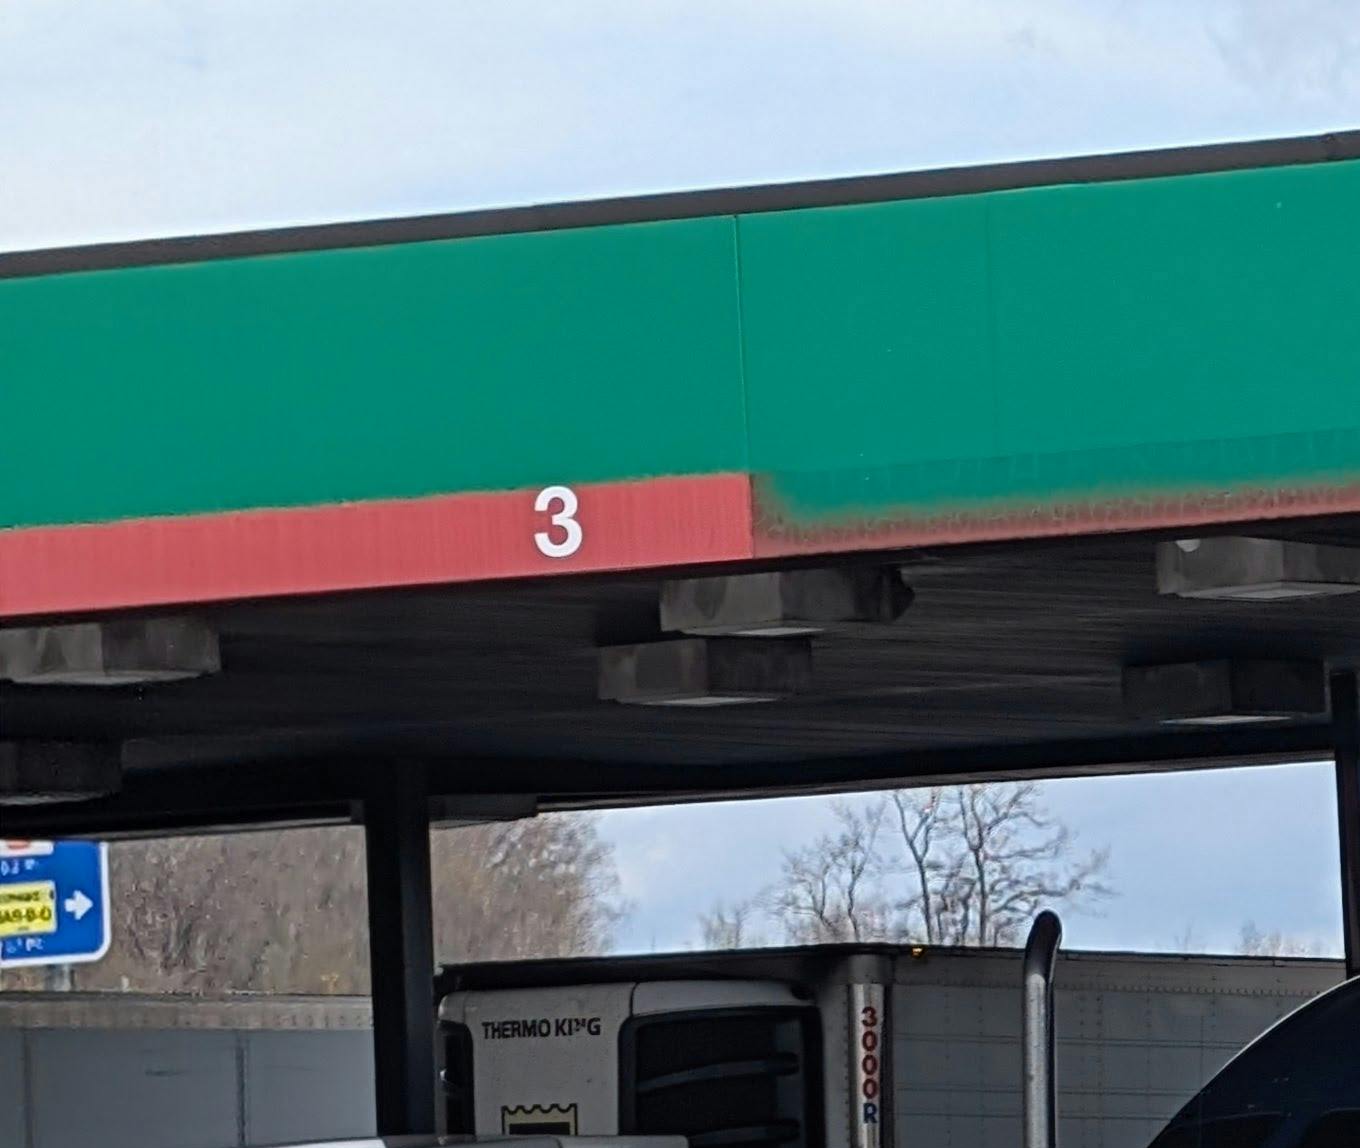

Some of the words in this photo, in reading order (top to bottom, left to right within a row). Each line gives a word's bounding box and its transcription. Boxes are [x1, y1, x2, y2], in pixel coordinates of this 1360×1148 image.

[534, 485, 583, 558] 3
[482, 1018, 551, 1039] THERMO
[555, 1017, 601, 1036] KING
[861, 1006, 878, 1124] 3000R
